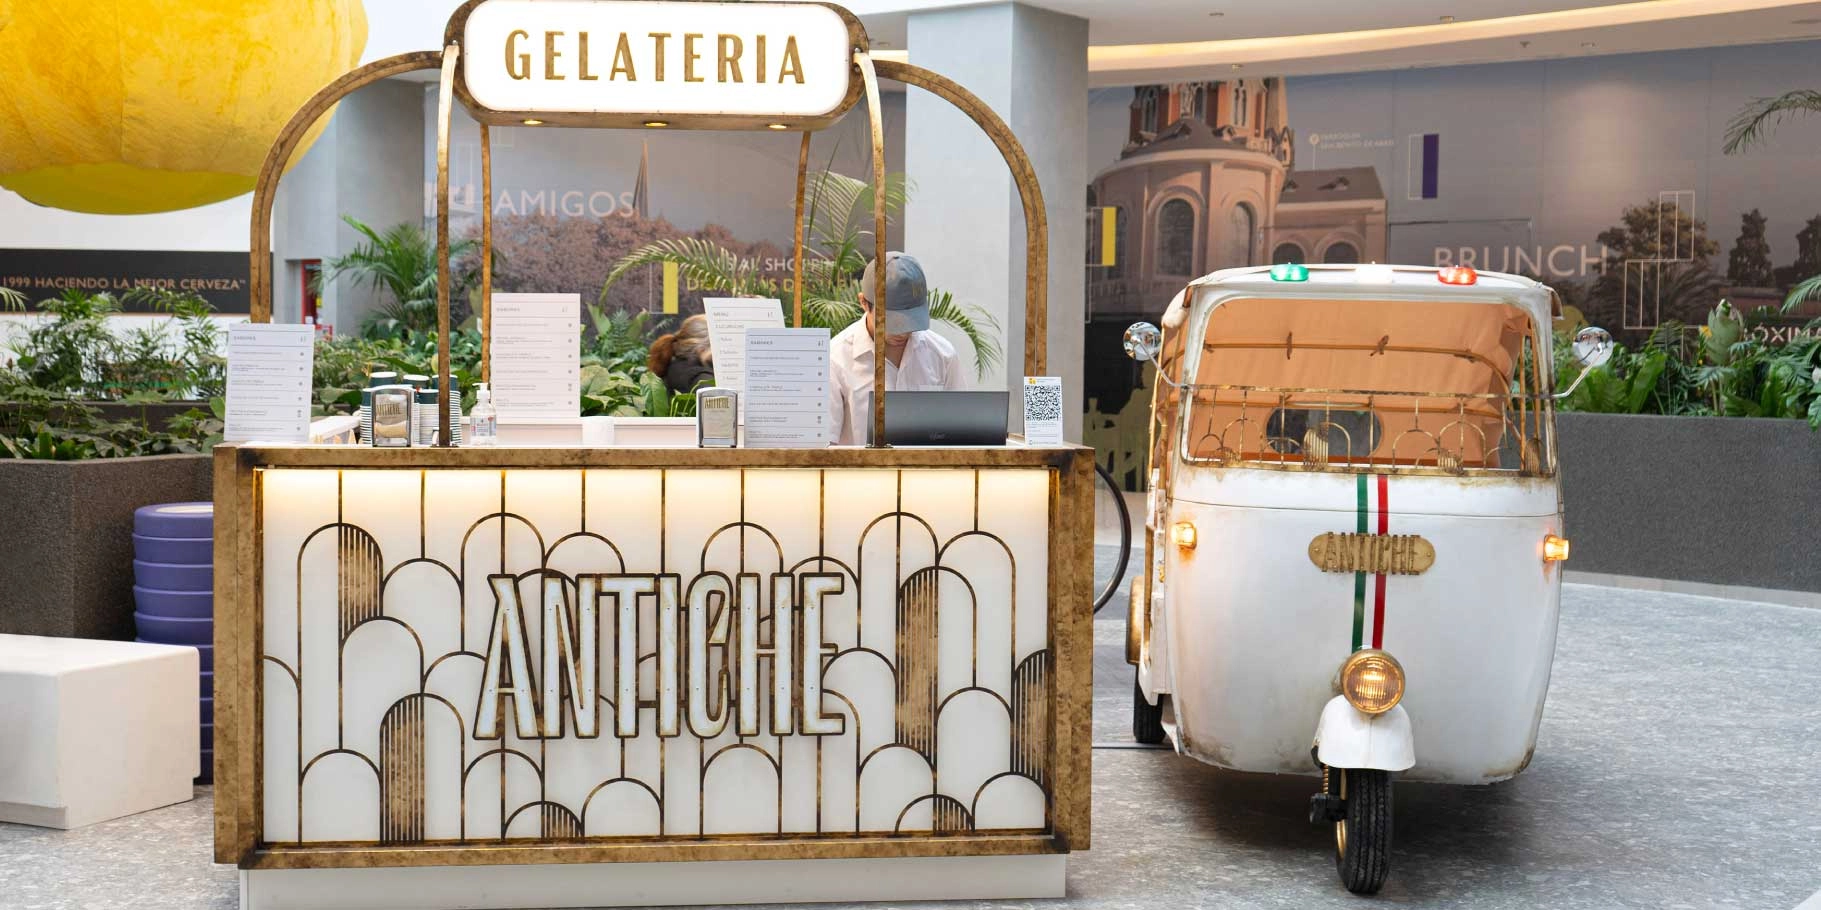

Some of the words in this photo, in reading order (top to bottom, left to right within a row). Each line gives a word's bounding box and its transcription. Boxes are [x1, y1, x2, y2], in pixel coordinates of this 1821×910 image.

[505, 29, 805, 84] GELATERIA
[494, 190, 635, 218] AMIGOS
[1434, 244, 1608, 277] BRUNCH
[2, 276, 30, 288] 1999
[35, 277, 109, 289] HACIENDO
[114, 277, 129, 289] LA
[1321, 532, 1421, 576] ANTICHE
[472, 570, 846, 740] ANTICHE
